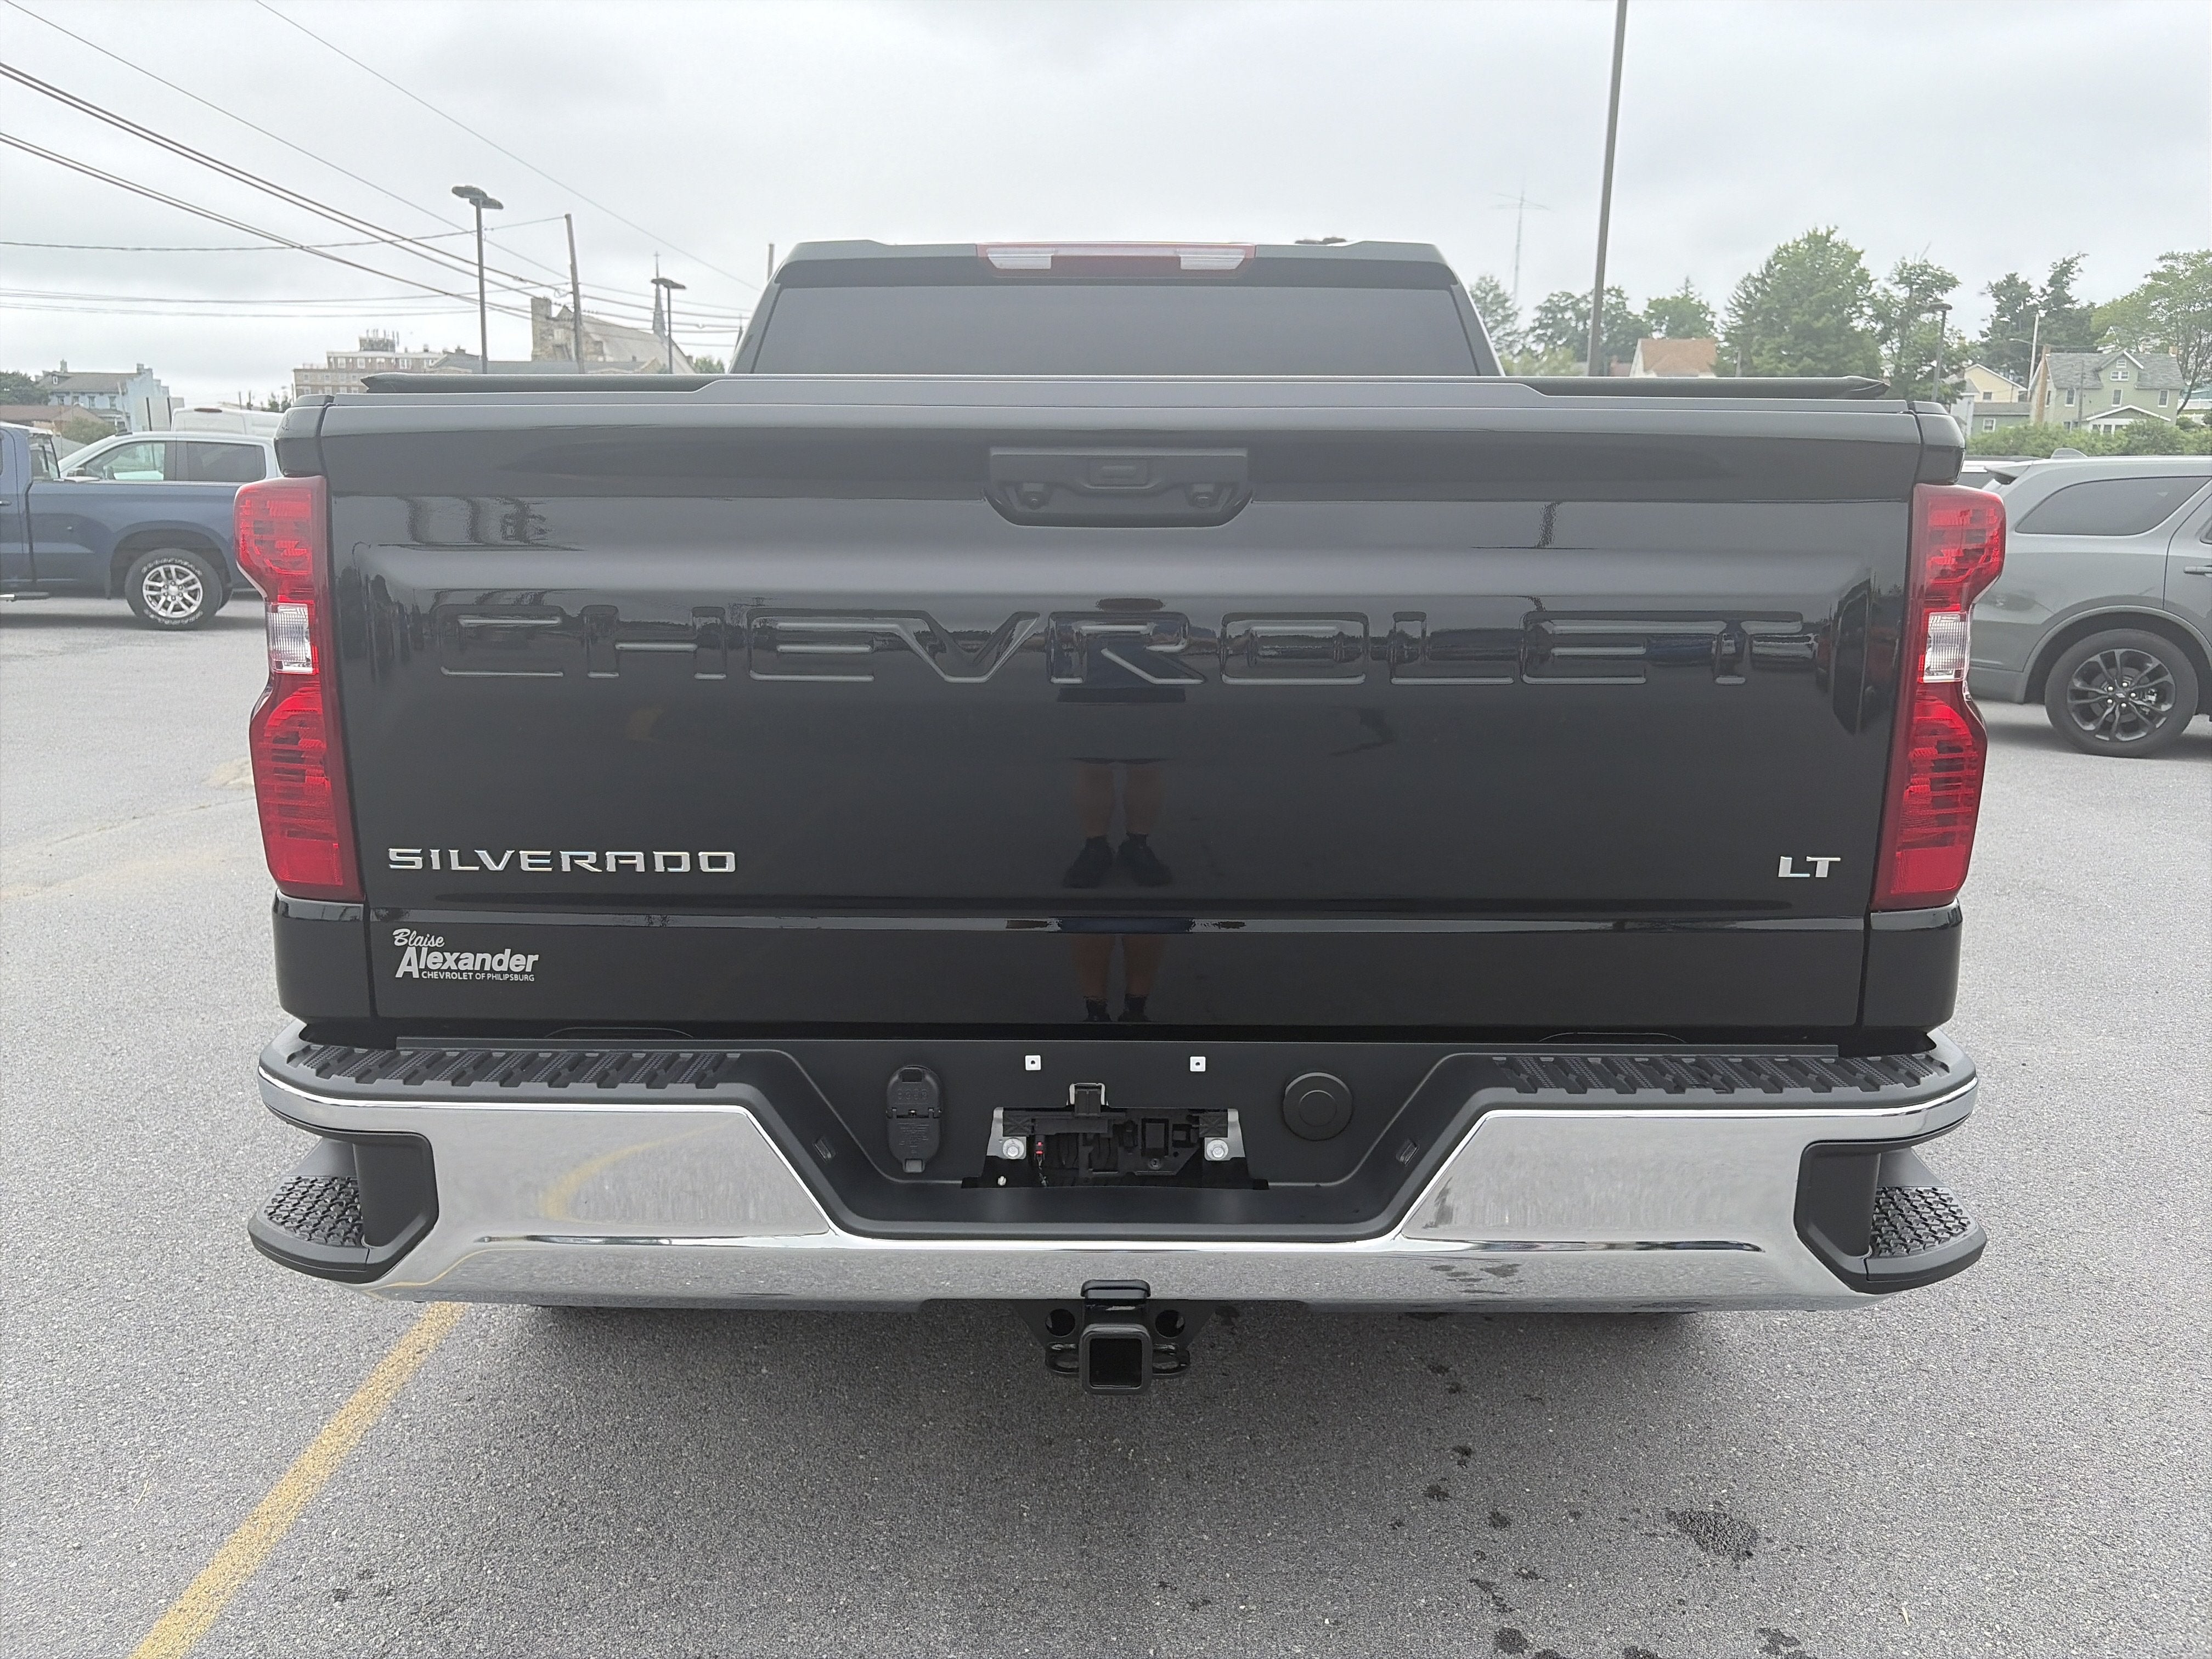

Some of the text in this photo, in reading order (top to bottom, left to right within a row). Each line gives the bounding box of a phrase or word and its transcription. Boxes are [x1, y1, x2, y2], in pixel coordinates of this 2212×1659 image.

[437, 603, 1803, 685] CHEVROLET
[388, 848, 736, 873] SILVERADO
[1778, 856, 1841, 878] LT
[392, 928, 445, 947] Blaise
[395, 946, 539, 978] Alexander
[421, 970, 535, 981] CHEVROLET OF PHILIPSBURG
